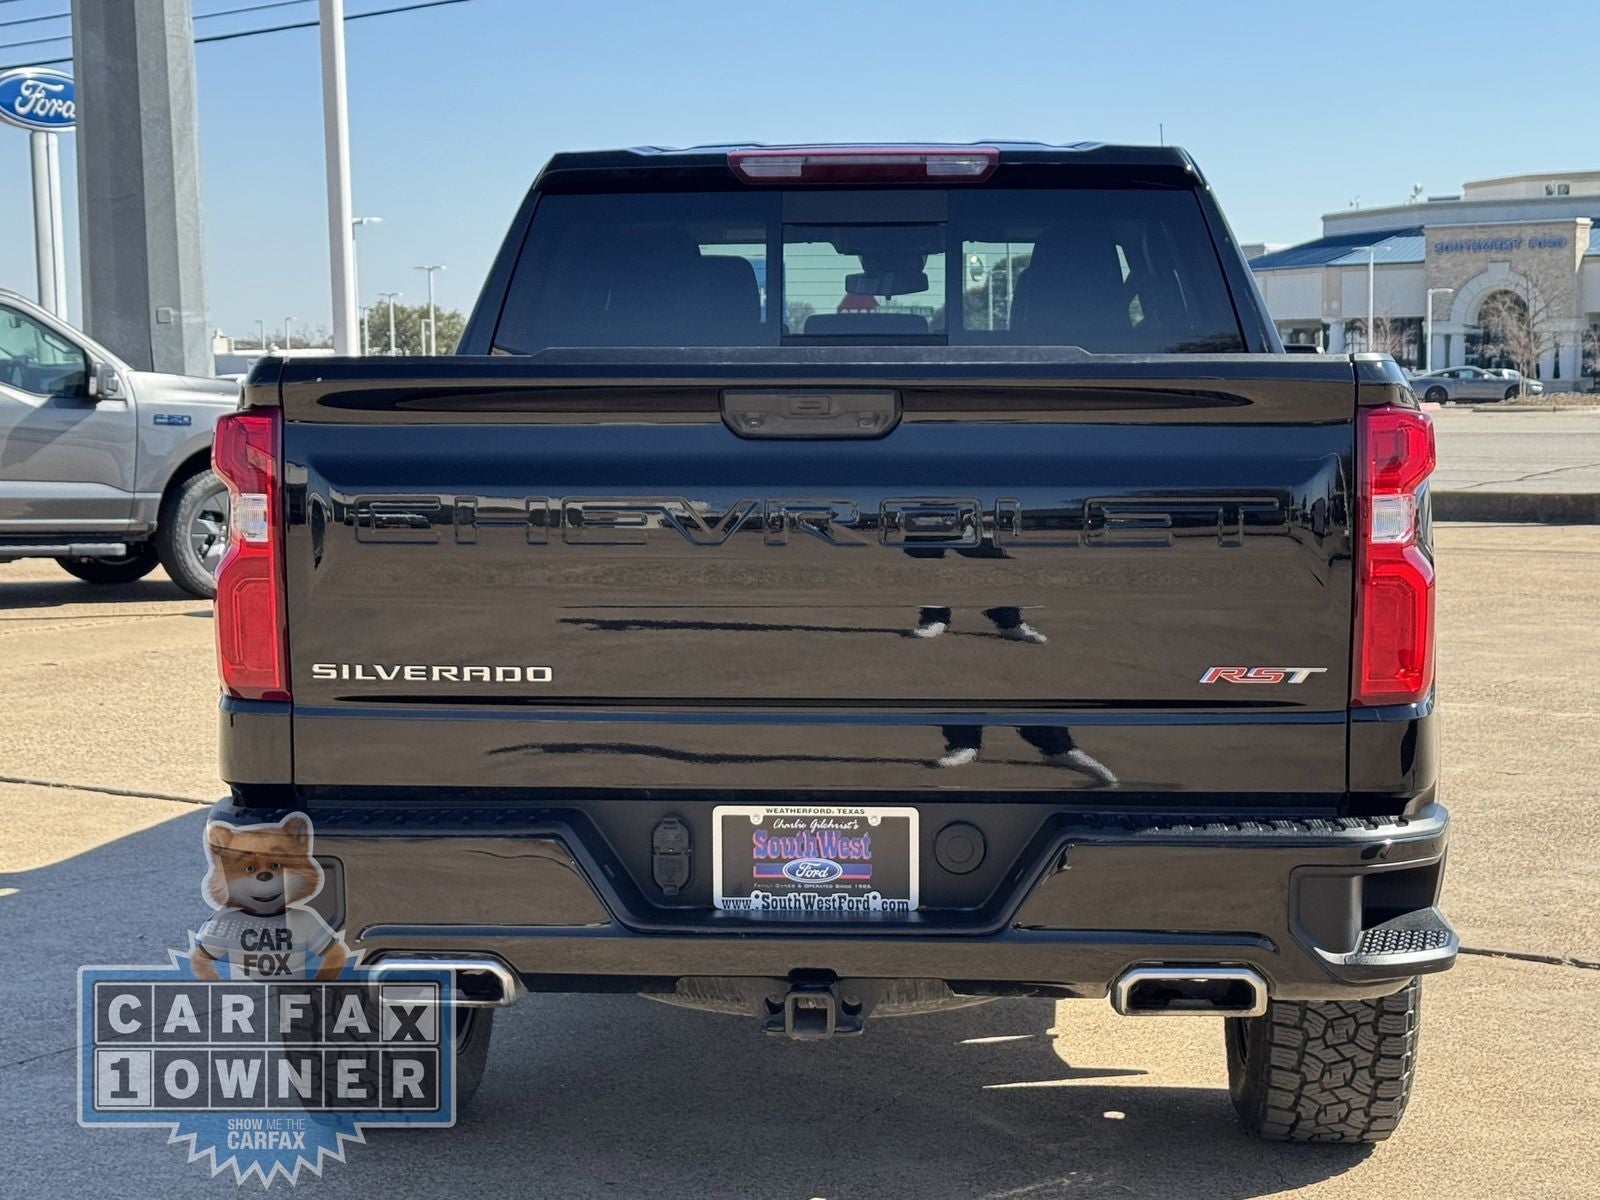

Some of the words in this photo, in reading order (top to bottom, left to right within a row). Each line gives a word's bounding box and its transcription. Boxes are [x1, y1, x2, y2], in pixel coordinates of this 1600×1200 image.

[354, 495, 1281, 548] CHEVROLET
[311, 663, 554, 683] SILVERADO
[1199, 665, 1328, 684] RST
[772, 818, 807, 830] Charlie
[809, 818, 860, 834] Gilchrist's
[752, 829, 873, 860] SouthWest
[795, 862, 830, 878] Ford
